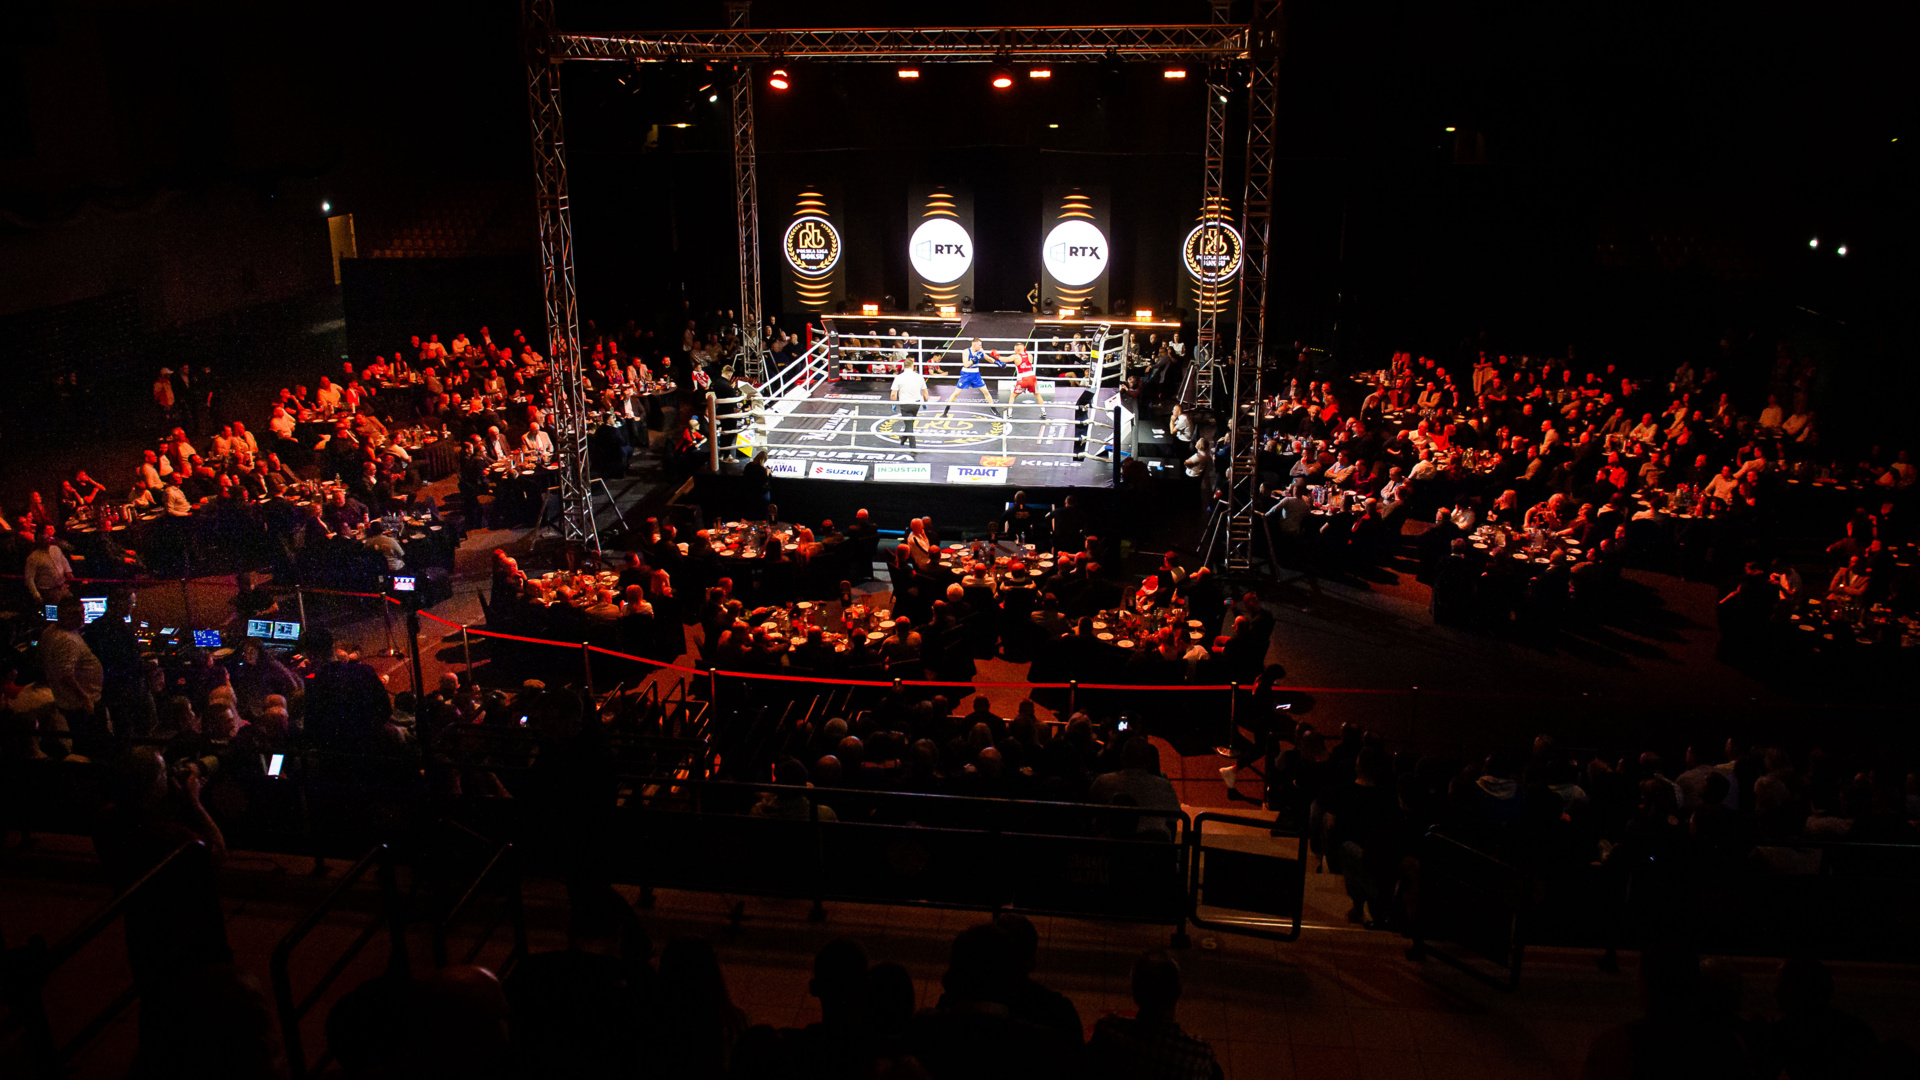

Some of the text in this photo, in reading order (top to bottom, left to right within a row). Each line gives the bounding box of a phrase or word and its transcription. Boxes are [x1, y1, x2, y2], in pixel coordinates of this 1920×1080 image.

[935, 244, 966, 258] RTX
[1069, 246, 1101, 260] RTX
[767, 449, 915, 462] INDUSTRIA
[957, 467, 999, 477] TRAKT
